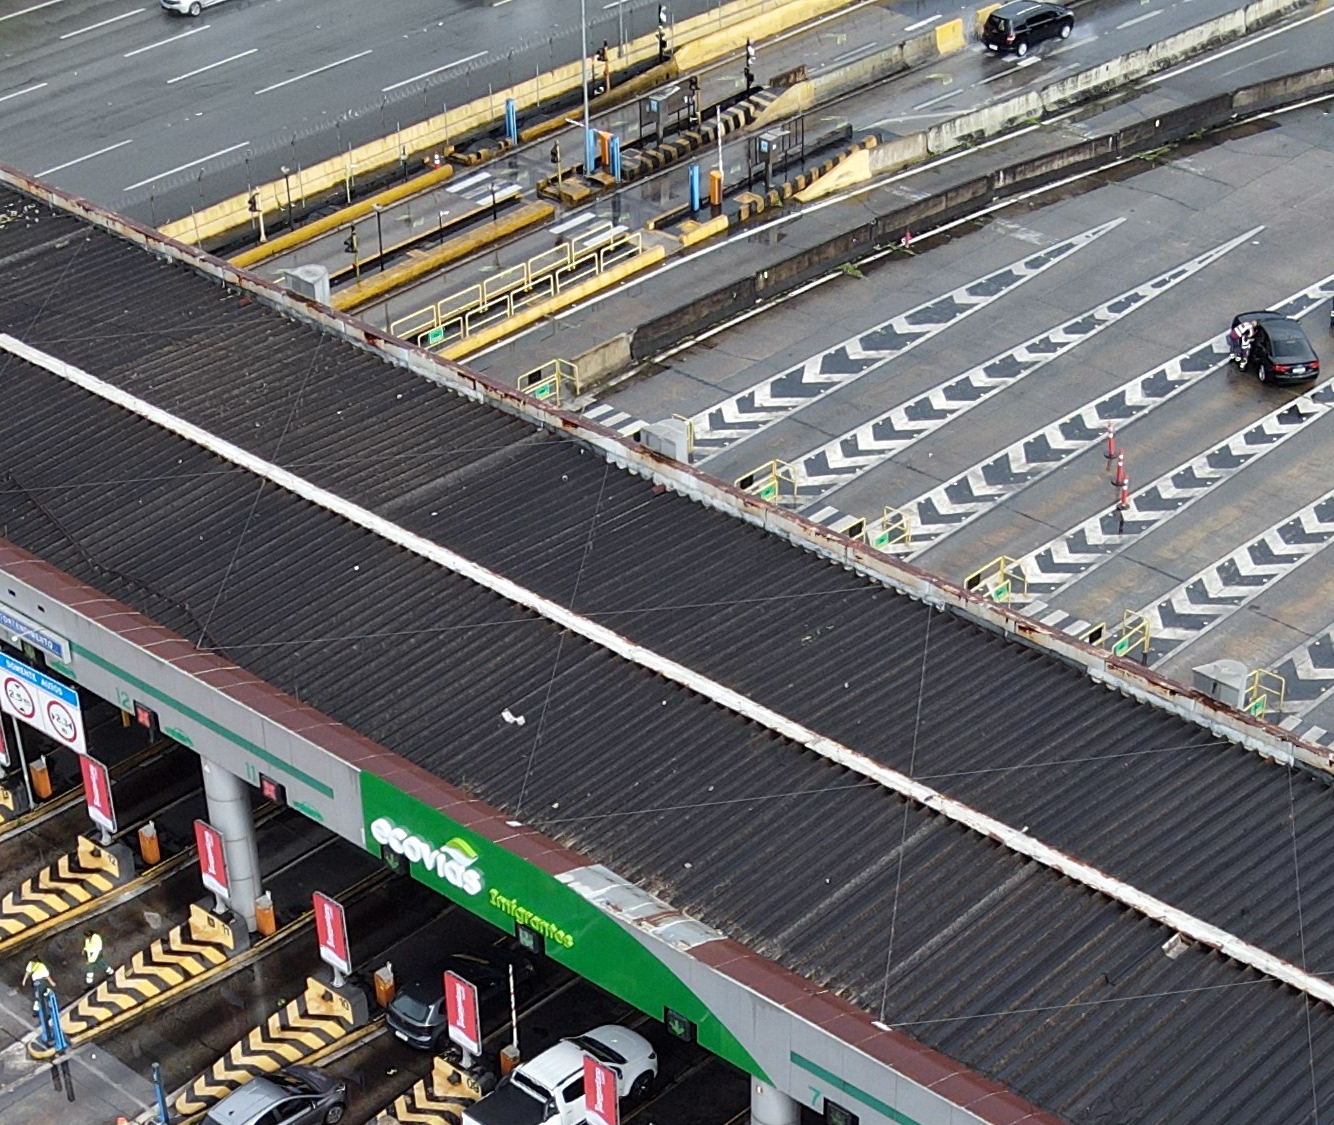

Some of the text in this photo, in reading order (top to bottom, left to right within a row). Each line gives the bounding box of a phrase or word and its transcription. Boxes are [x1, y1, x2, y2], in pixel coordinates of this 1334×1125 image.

[116, 687, 131, 709] 12
[246, 761, 257, 782] 11
[371, 817, 484, 896] ecovias
[489, 888, 575, 949] Imigrantes
[808, 1086, 822, 1106] 7
